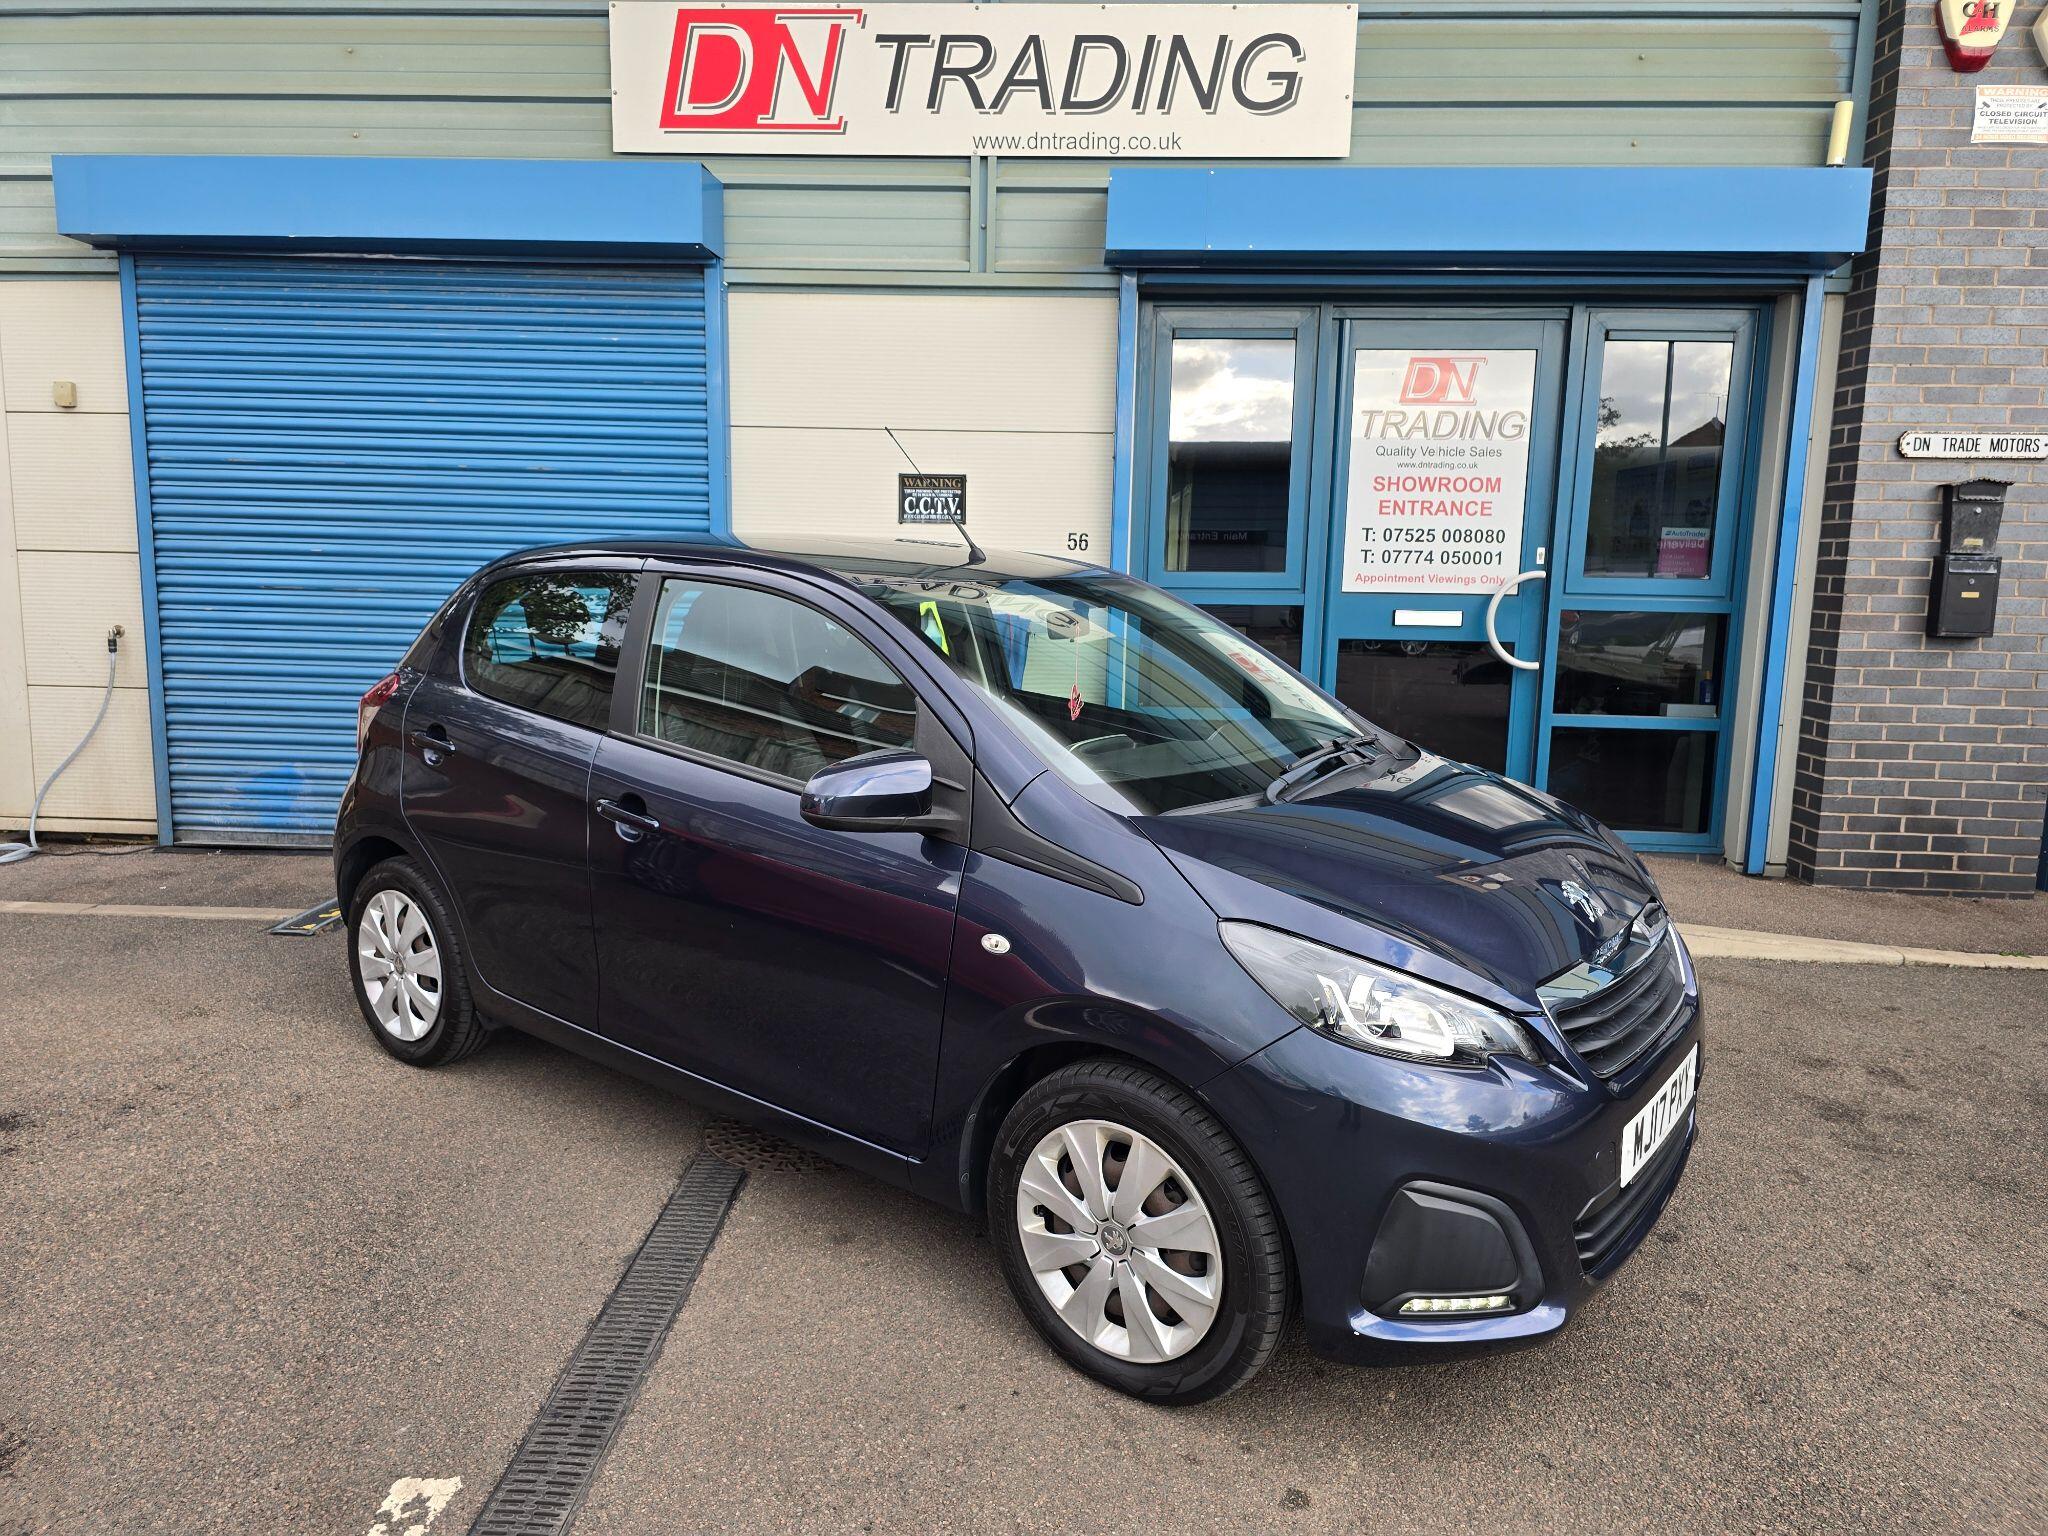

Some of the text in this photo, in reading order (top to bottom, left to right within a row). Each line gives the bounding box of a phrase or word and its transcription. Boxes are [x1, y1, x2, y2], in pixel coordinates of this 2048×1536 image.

[1961, 24, 2000, 33] ALARMS
[669, 9, 1306, 131] DN TRADING
[1983, 88, 2048, 96] WARNING
[972, 131, 1182, 155] www.dntrading.co.uk
[1403, 357, 1488, 405] DN
[1361, 410, 1527, 441] TRADING
[1375, 445, 1502, 459] Quality Vehicle Sales
[1913, 437, 2041, 453] DN TRADE MOTORS
[1396, 461, 1478, 470] www.dntrading.co.uk
[903, 478, 961, 488] WARNING
[1373, 476, 1502, 493] SHOWROOM
[1378, 500, 1493, 517] ENTRANCE
[1067, 532, 1089, 550] 56
[1362, 528, 1506, 544] T: 07525 008080
[1361, 549, 1503, 566] T: 07774 050001
[1355, 573, 1505, 587] Appointment Viewings Only
